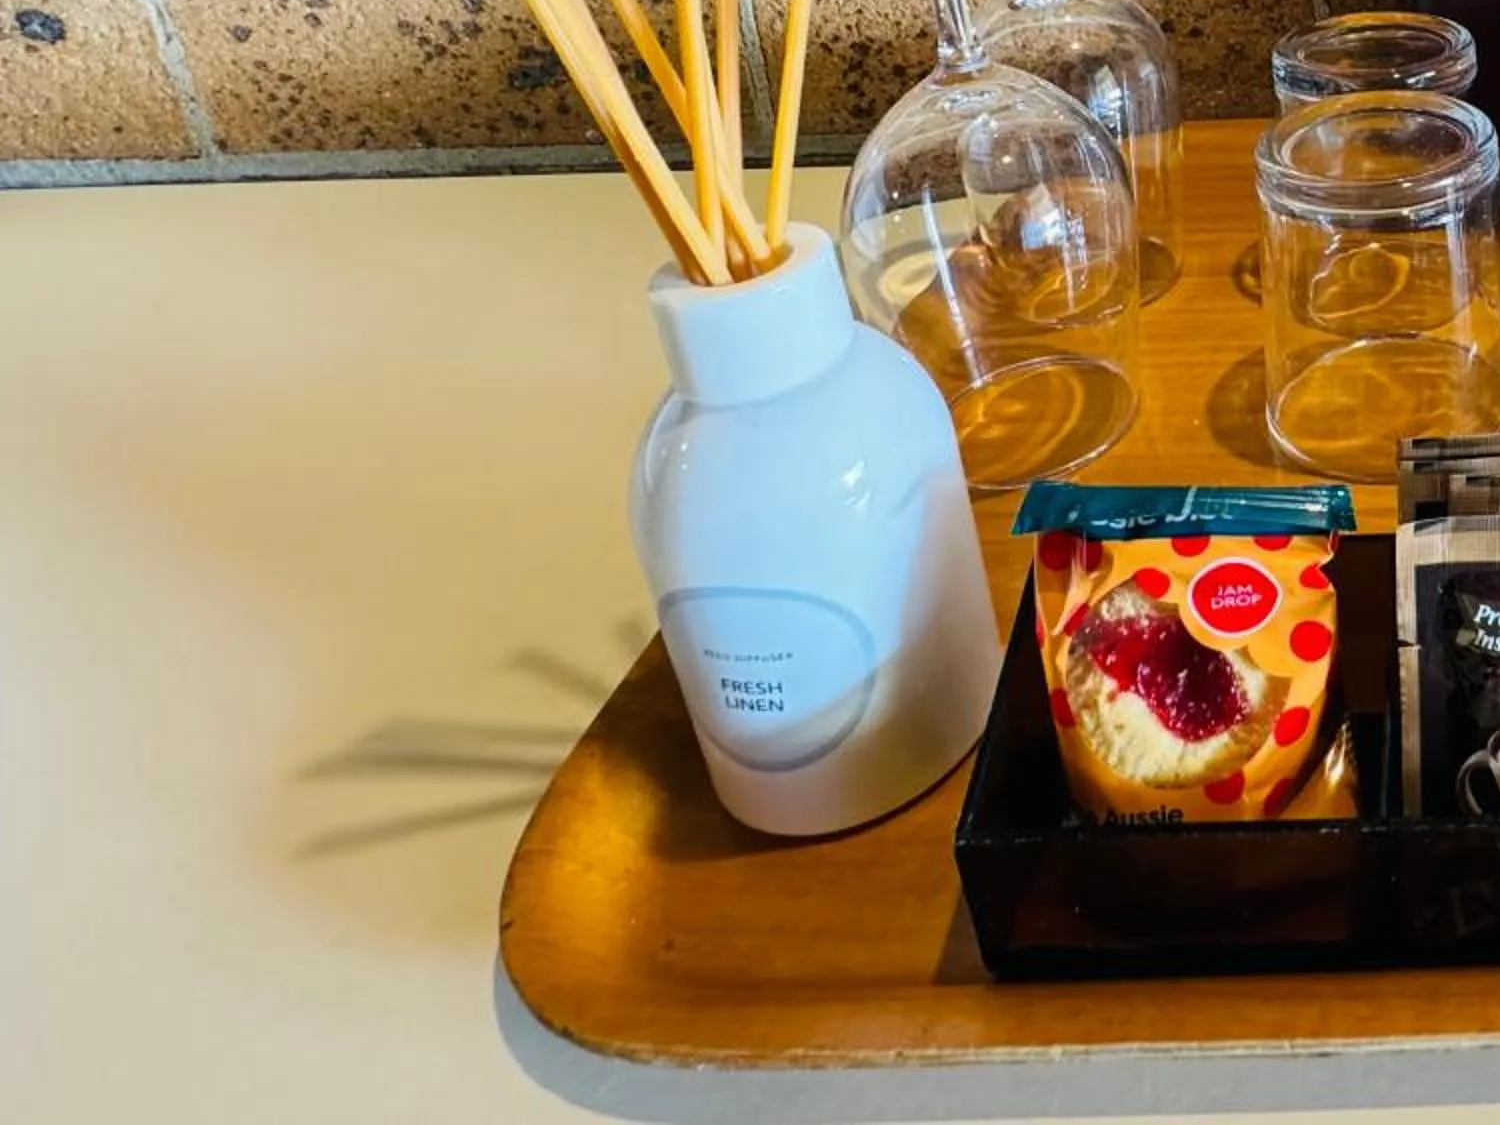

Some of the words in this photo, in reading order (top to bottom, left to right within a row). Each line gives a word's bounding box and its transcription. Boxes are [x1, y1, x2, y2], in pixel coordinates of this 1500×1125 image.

[1216, 584, 1253, 596] JAM
[1210, 593, 1263, 610] DROP
[720, 677, 784, 696] FRESH
[724, 695, 786, 713] LINEN
[1103, 804, 1185, 830] Aussie
